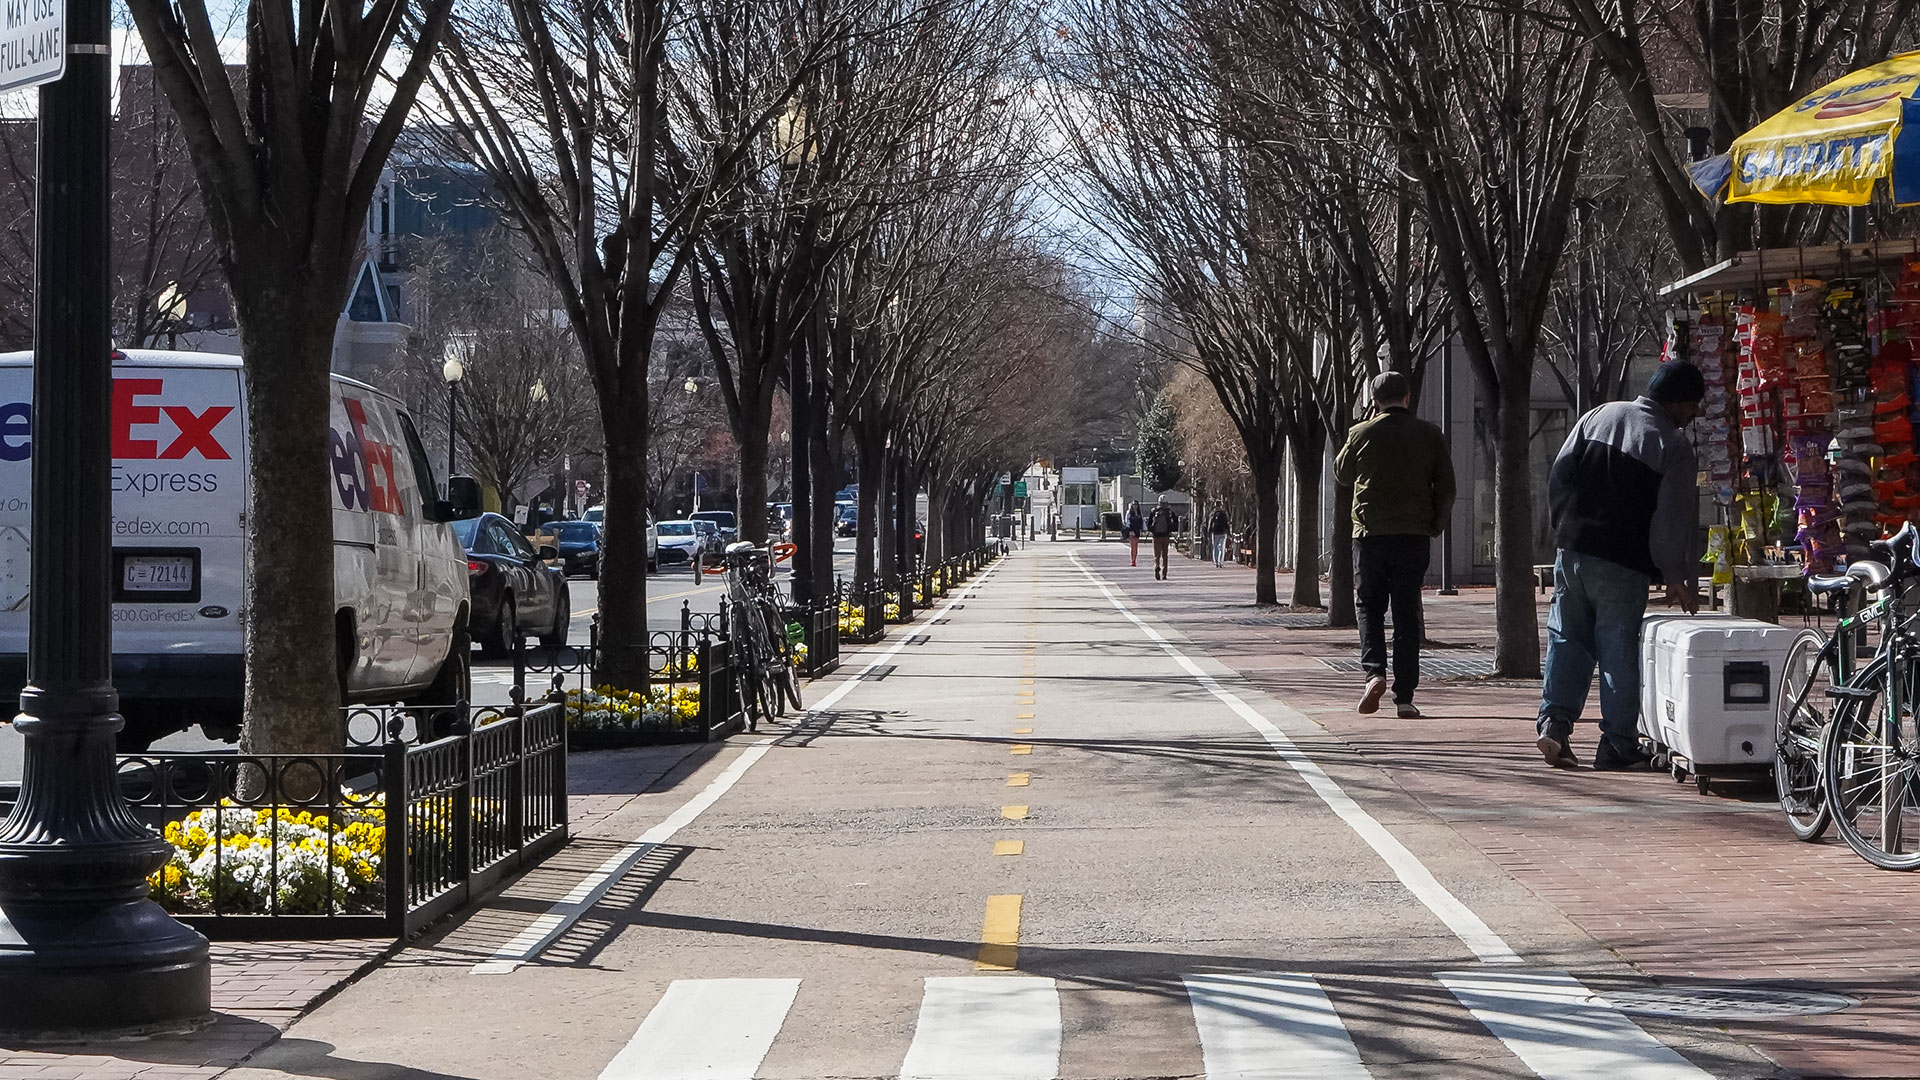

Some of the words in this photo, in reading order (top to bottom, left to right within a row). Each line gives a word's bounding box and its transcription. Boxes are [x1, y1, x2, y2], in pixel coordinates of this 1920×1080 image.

[7, 0, 28, 30] MAY
[34, 0, 54, 21] USE
[0, 38, 27, 73] FULL
[32, 27, 60, 64] LANE
[0, 379, 235, 461] eEx
[330, 397, 404, 516] edEx
[112, 466, 217, 497] Express
[150, 566, 187, 582] 72144
[1860, 603, 1884, 623] GMC
